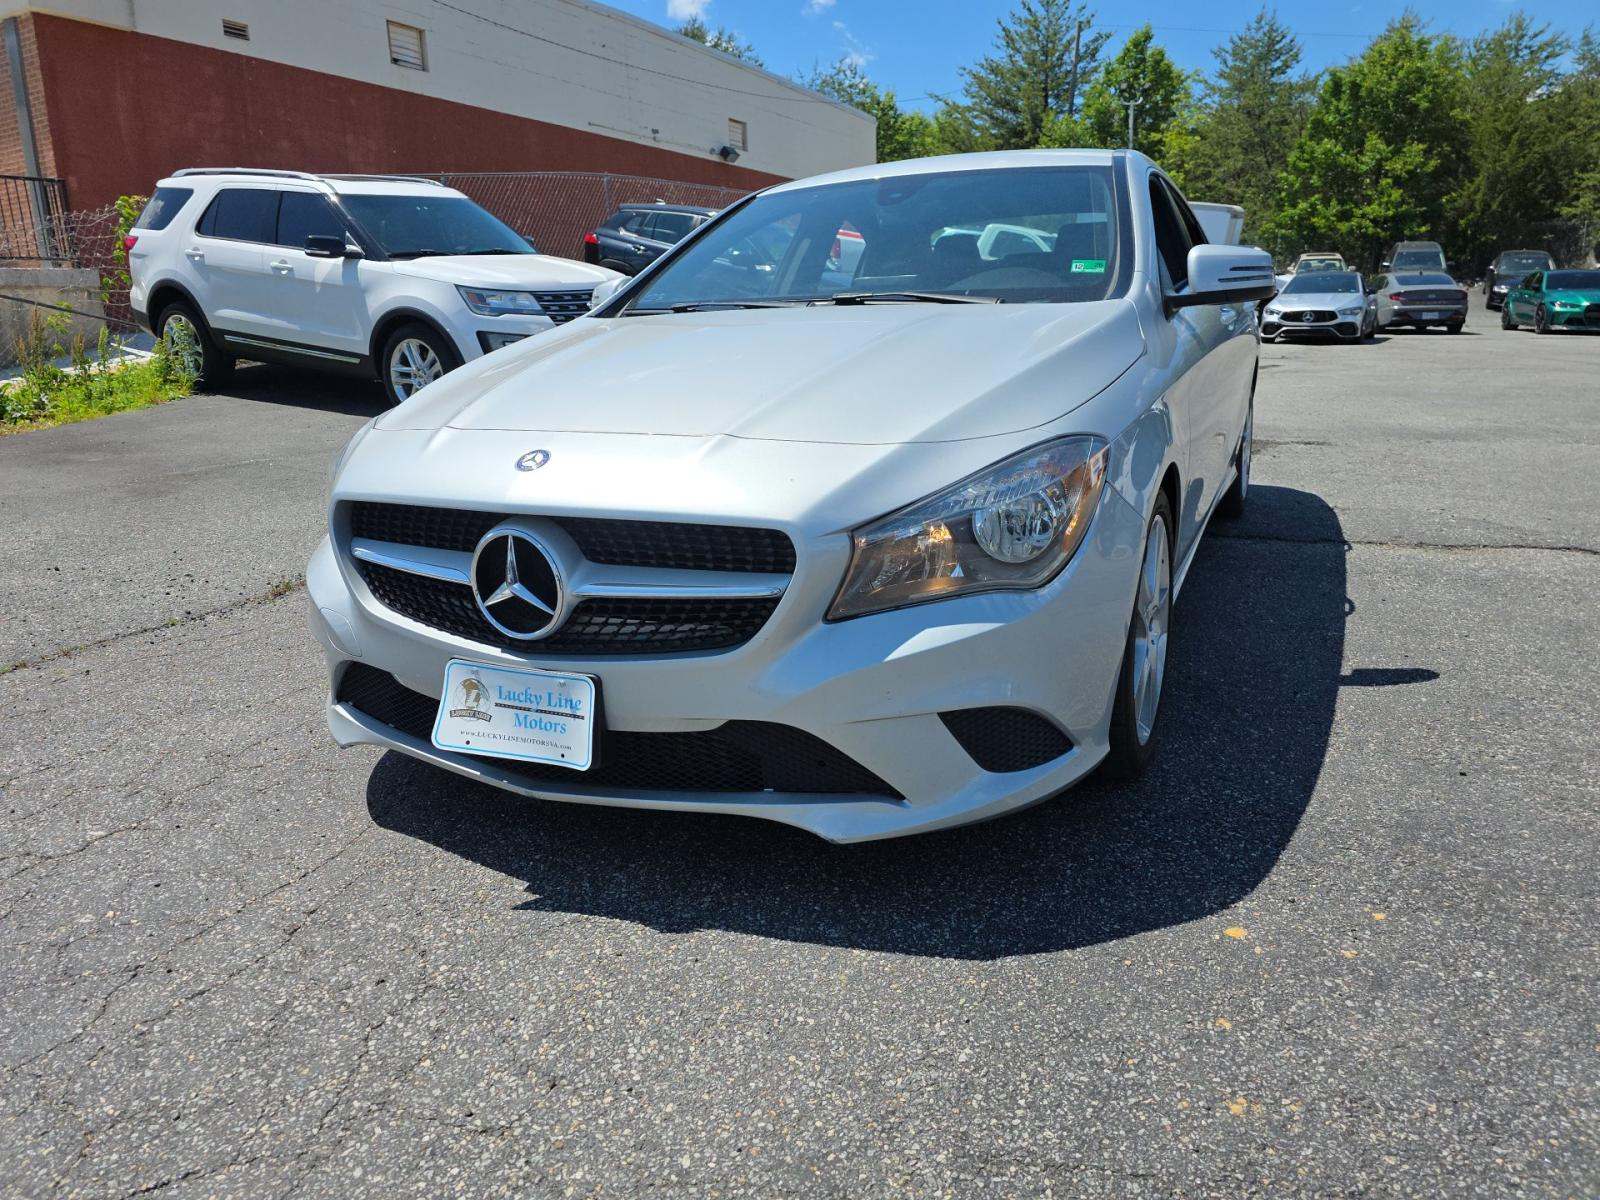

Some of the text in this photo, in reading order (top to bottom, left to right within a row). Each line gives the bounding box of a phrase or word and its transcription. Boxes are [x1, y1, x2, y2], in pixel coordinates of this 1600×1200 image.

[497, 685, 582, 711] Lucky Line
[514, 712, 567, 734] Motors
